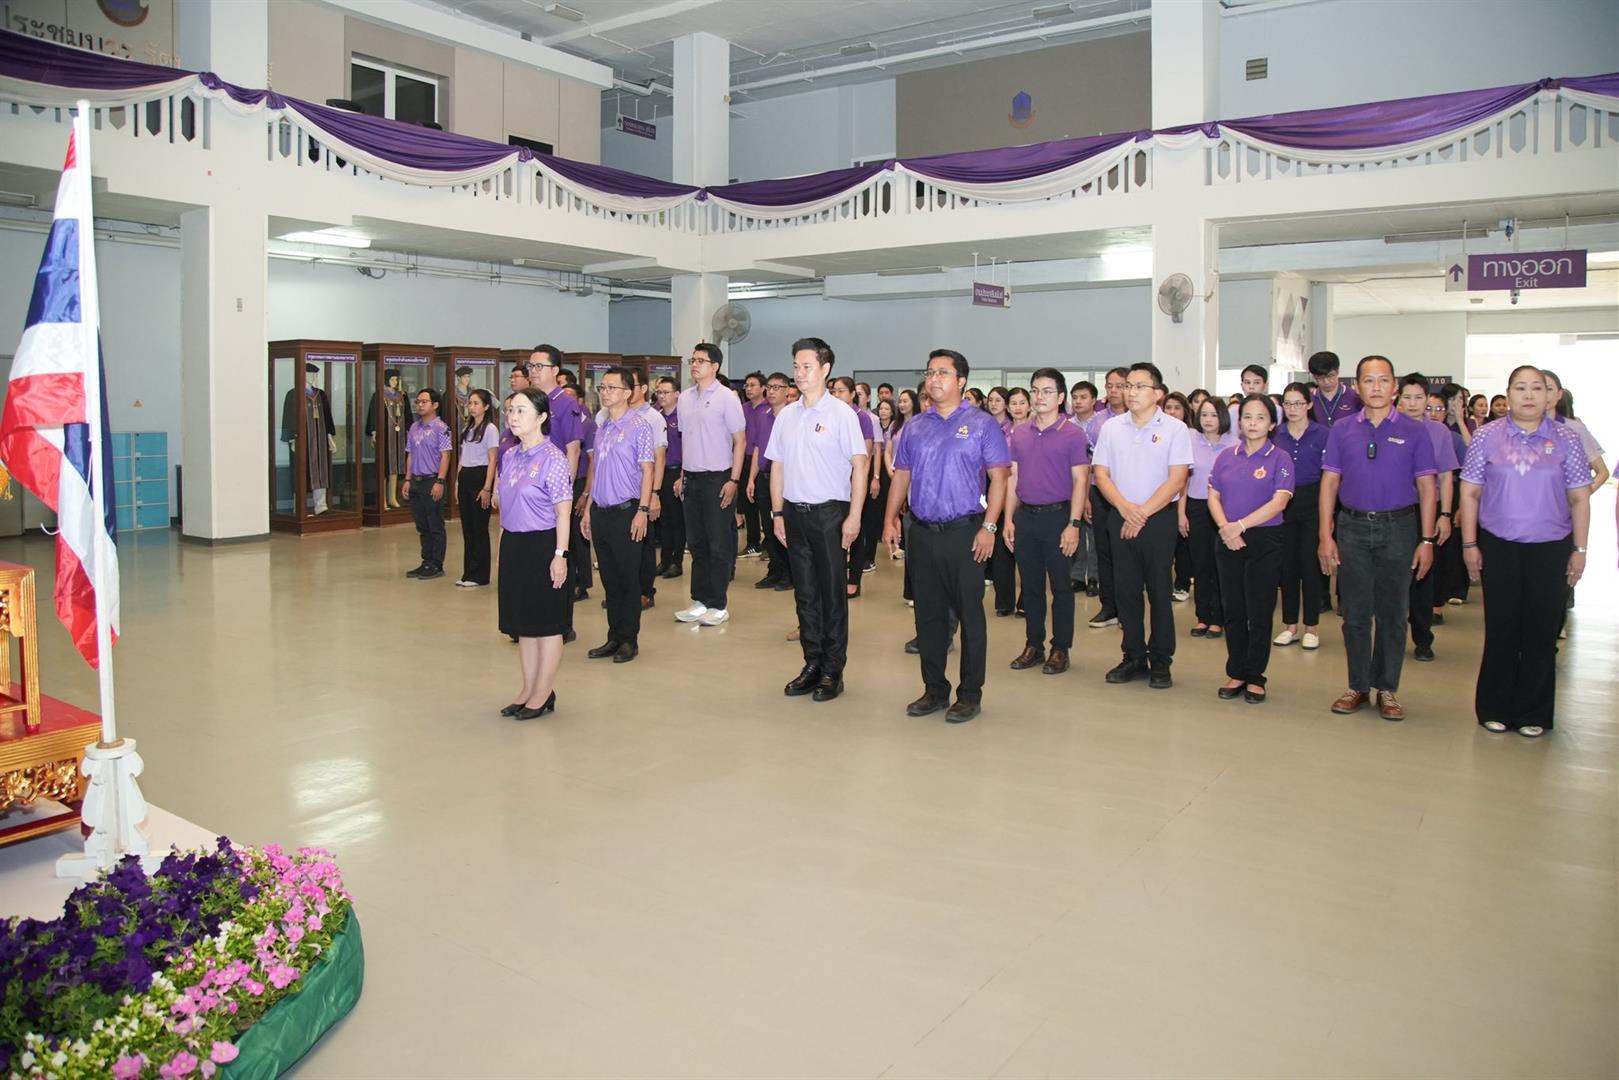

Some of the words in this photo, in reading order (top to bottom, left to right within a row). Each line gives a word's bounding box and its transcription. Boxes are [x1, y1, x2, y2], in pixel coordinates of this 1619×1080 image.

[1483, 258, 1572, 277] ทางออก
[1515, 277, 1539, 288] Exit
